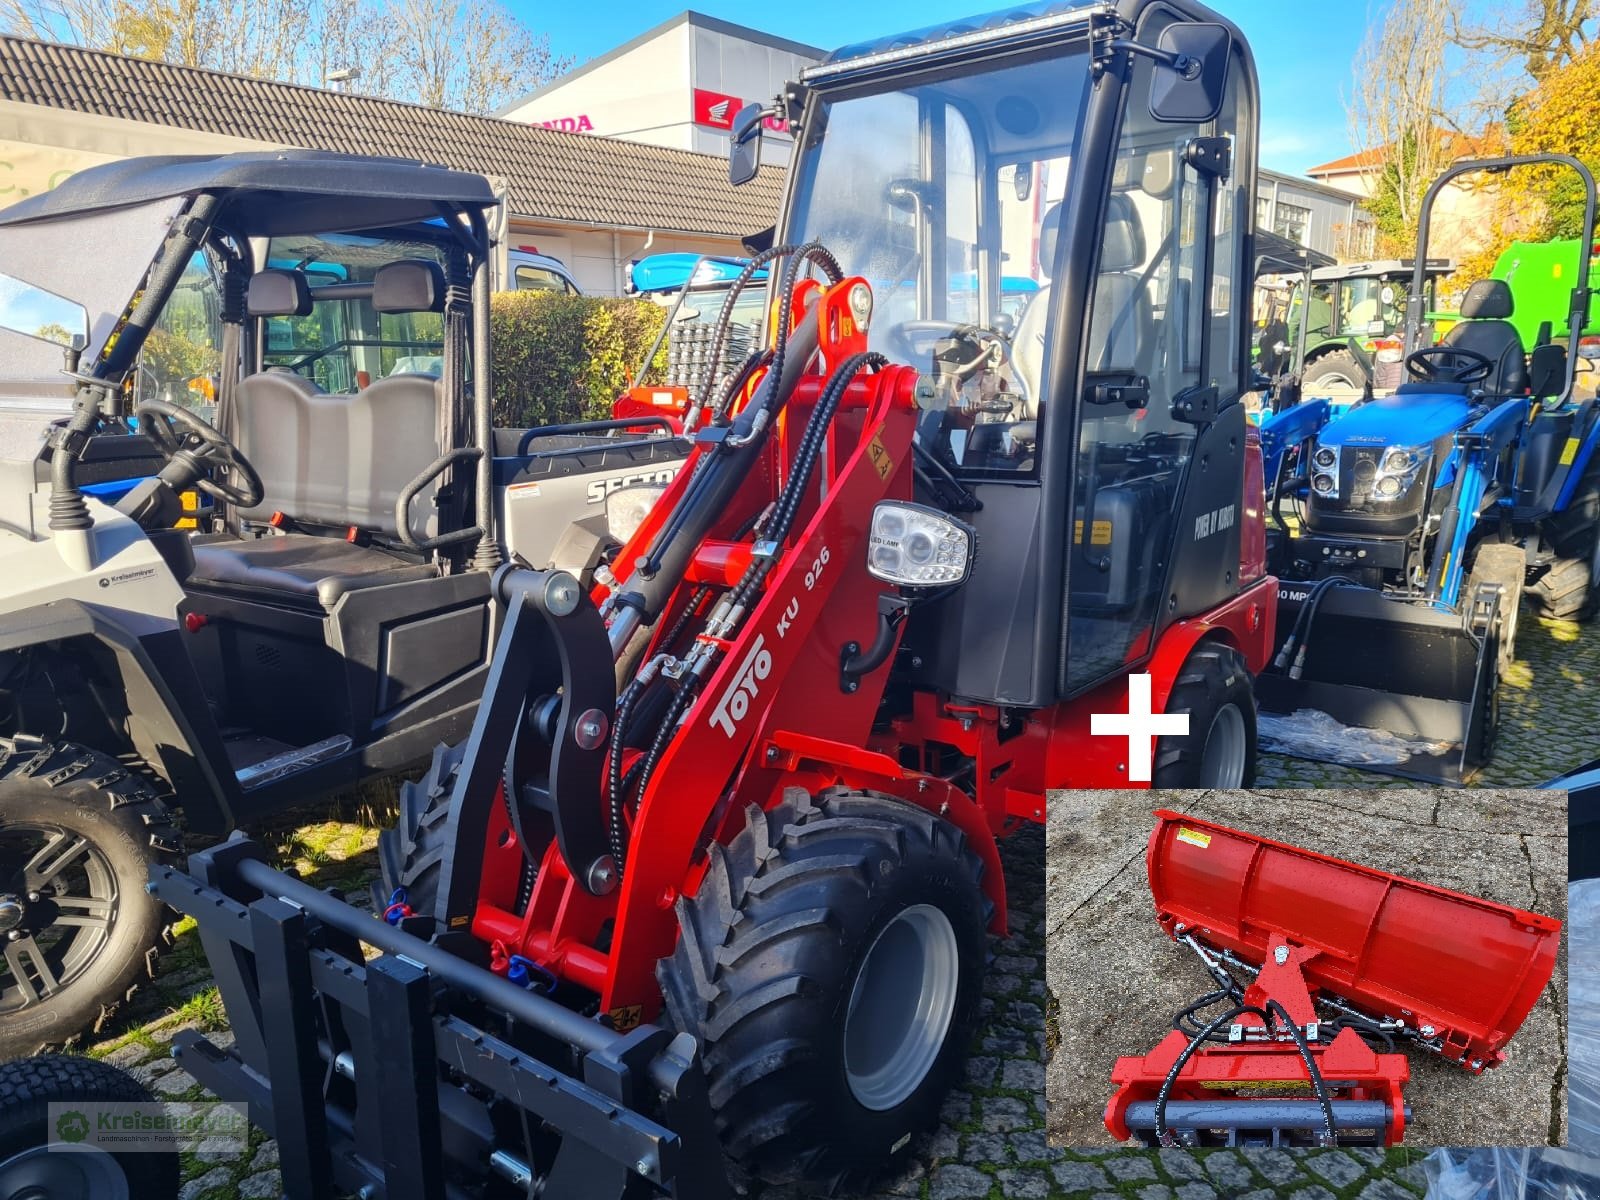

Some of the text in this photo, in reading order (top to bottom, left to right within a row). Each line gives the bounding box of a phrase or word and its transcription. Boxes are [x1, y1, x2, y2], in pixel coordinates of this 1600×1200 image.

[587, 468, 682, 504] SECTO
[709, 546, 830, 739] TOYO KU 926
